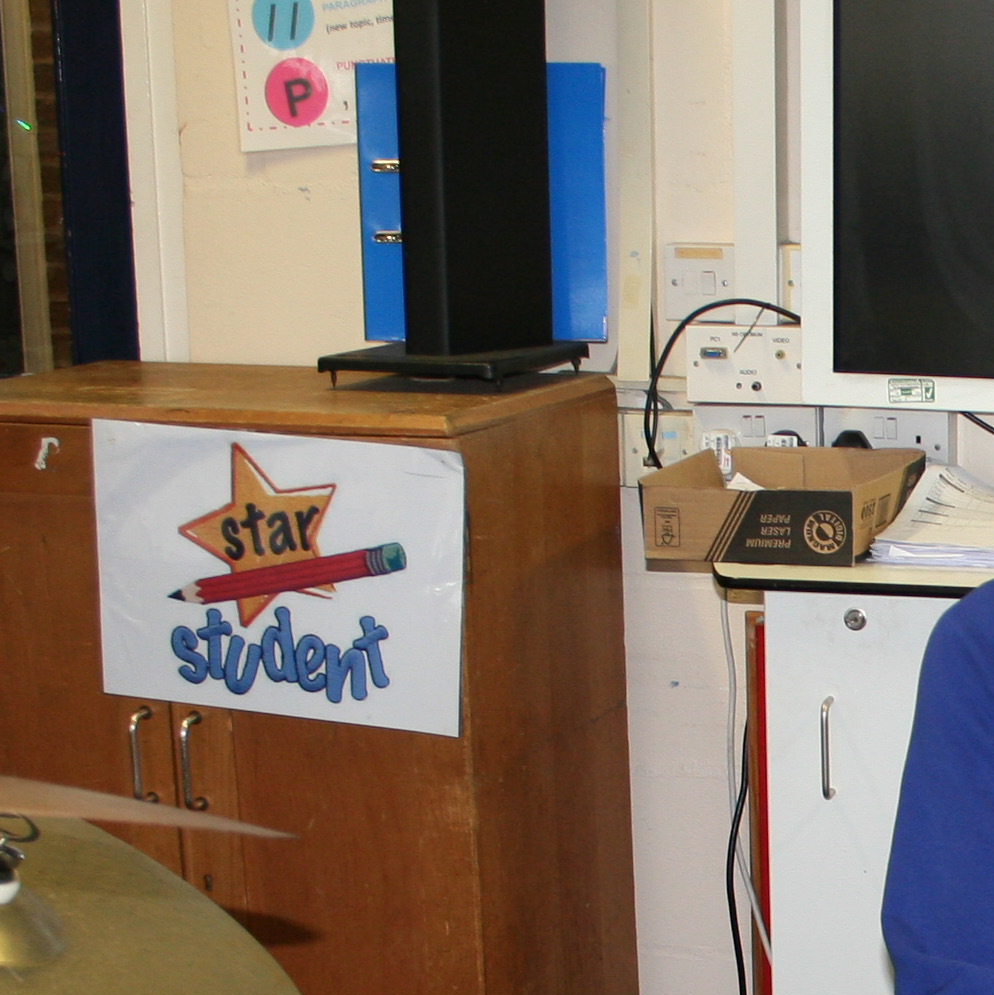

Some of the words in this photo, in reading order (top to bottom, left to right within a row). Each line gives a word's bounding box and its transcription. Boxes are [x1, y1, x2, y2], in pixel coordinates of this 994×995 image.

[284, 78, 312, 117] P
[760, 514, 791, 524] PAPER
[760, 526, 792, 537] LASER
[220, 502, 320, 562] star
[745, 539, 792, 549] PREMIUM
[170, 605, 391, 704] student
